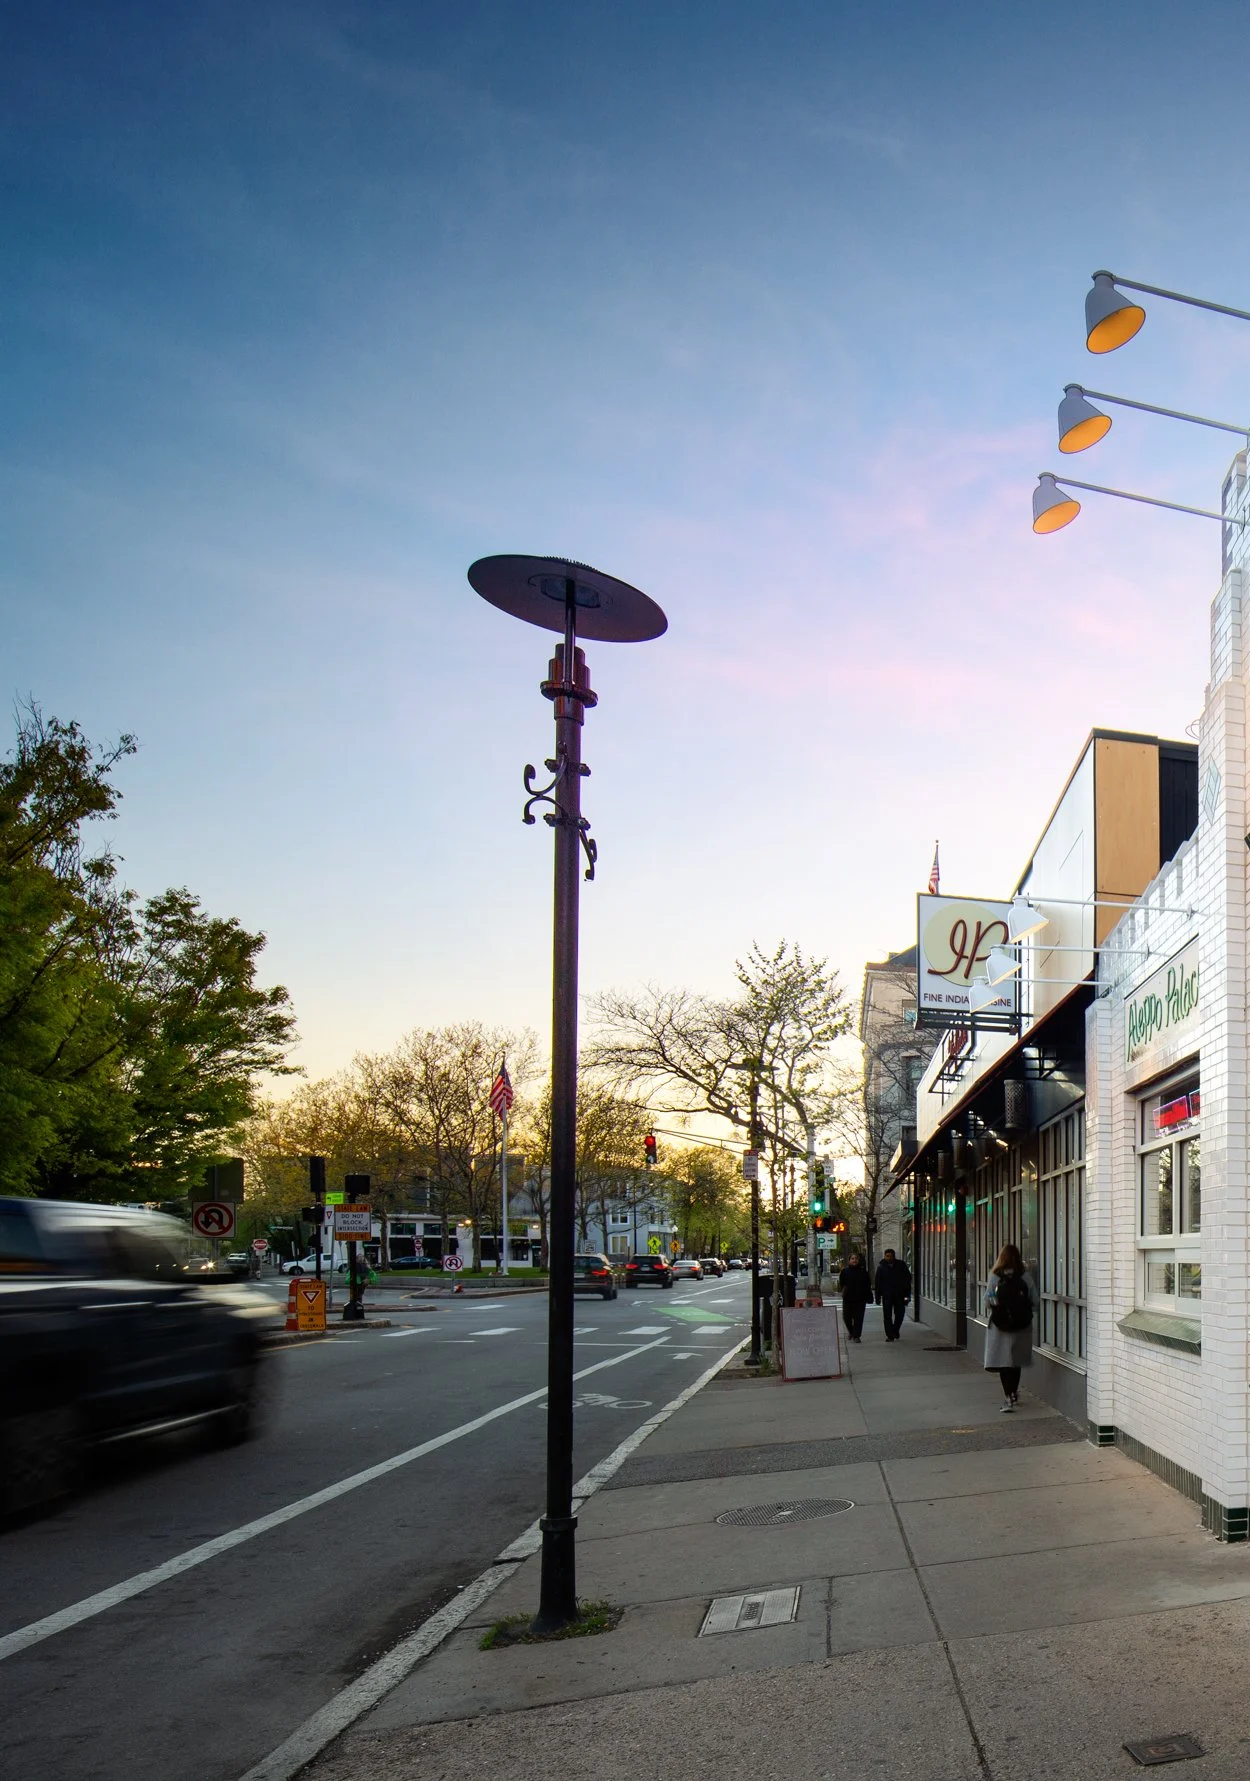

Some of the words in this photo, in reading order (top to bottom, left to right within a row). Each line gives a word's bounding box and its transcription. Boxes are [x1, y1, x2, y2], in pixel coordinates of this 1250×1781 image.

[923, 993, 943, 1002] FINE
[945, 994, 969, 1004] INDIA
[1127, 993, 1162, 1062] Aleppo
[1165, 963, 1199, 1028] Palac
